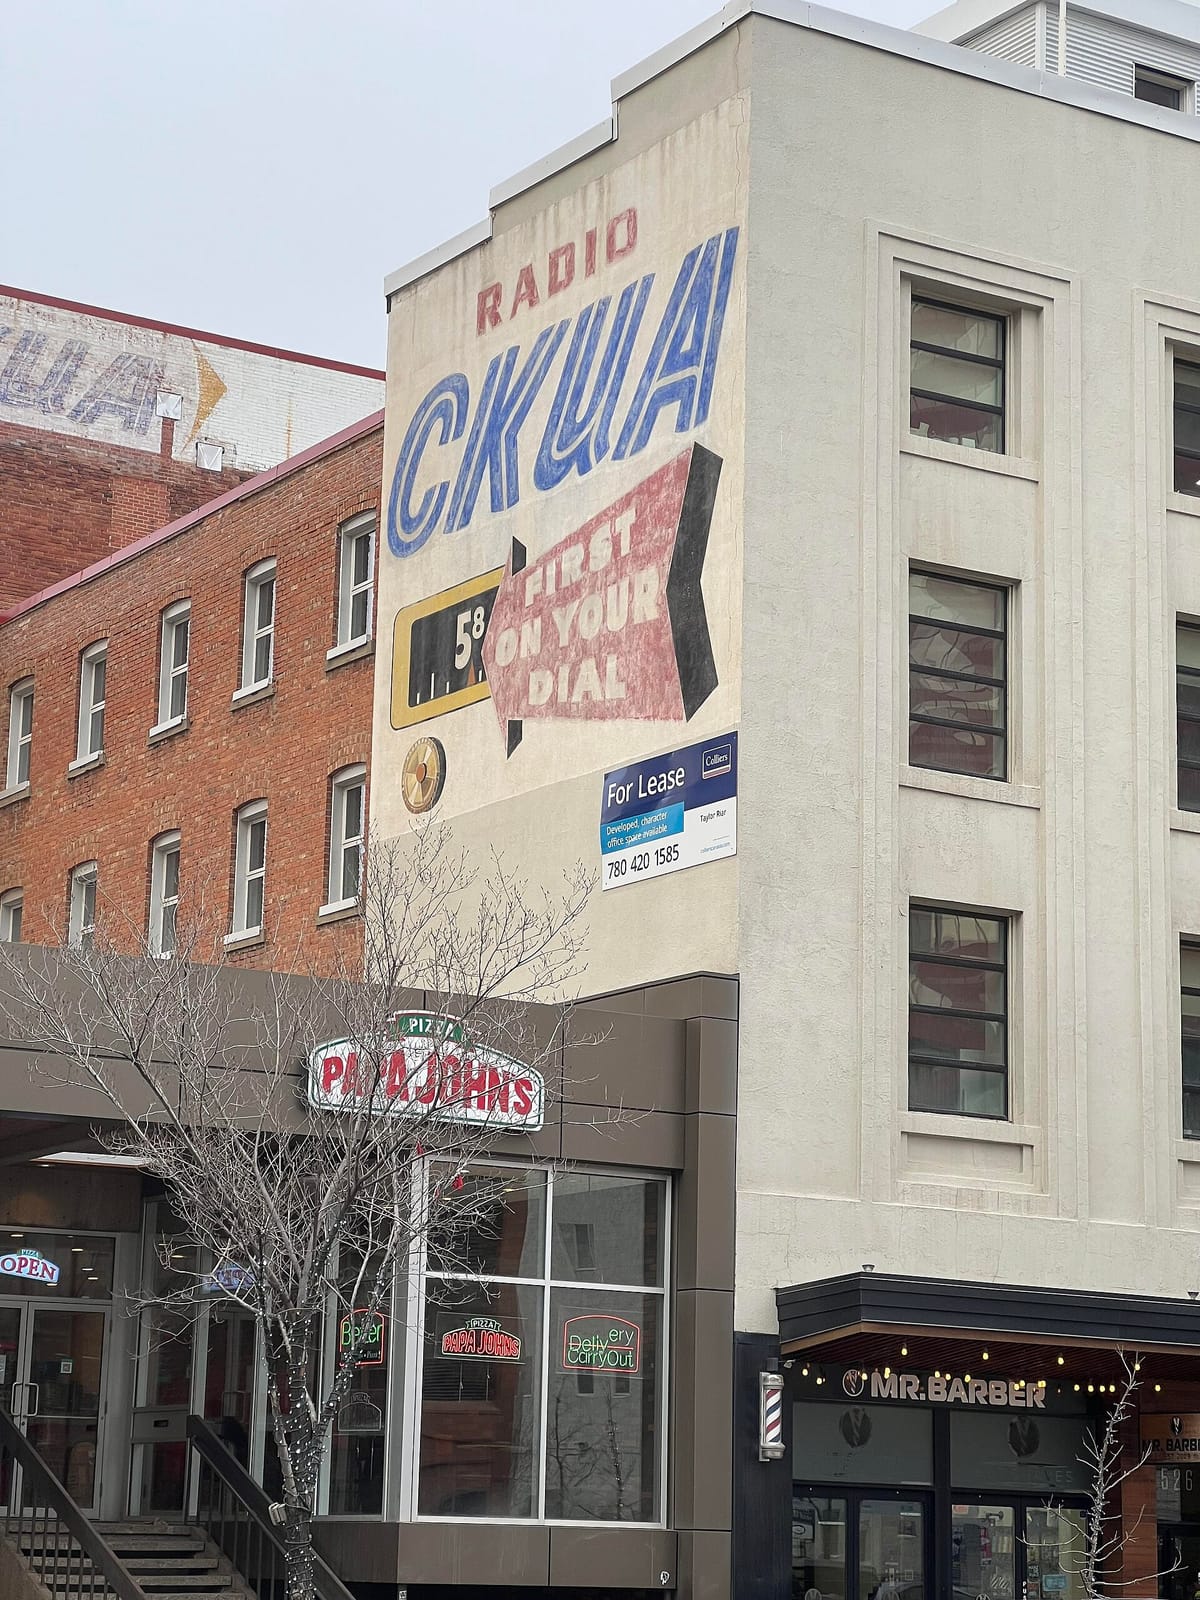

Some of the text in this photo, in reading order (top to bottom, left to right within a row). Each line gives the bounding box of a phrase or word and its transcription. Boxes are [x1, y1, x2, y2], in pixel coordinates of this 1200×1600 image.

[477, 207, 638, 336] RADIO
[0, 326, 167, 436] UA
[387, 226, 740, 558] CKUA
[525, 508, 637, 608] FIRST
[495, 568, 660, 667] ON YOUR
[528, 653, 628, 706] DIAL
[705, 753, 728, 767] Colliers
[607, 767, 685, 808] For Lease
[606, 810, 668, 836] Developed, character
[700, 811, 716, 824] Taylor
[607, 824, 668, 849] office space available
[607, 859, 627, 880] 780
[630, 852, 650, 873] 420
[654, 843, 680, 867] 1585
[408, 1017, 455, 1038] PIZZA
[1, 1256, 56, 1280] OPEN
[341, 1321, 383, 1346] Beer
[472, 1319, 495, 1329] PIZZA
[443, 1329, 520, 1357] PAPA JOHNS
[1166, 1438, 1200, 1452] BARB
[1161, 1467, 1193, 1491] 526
